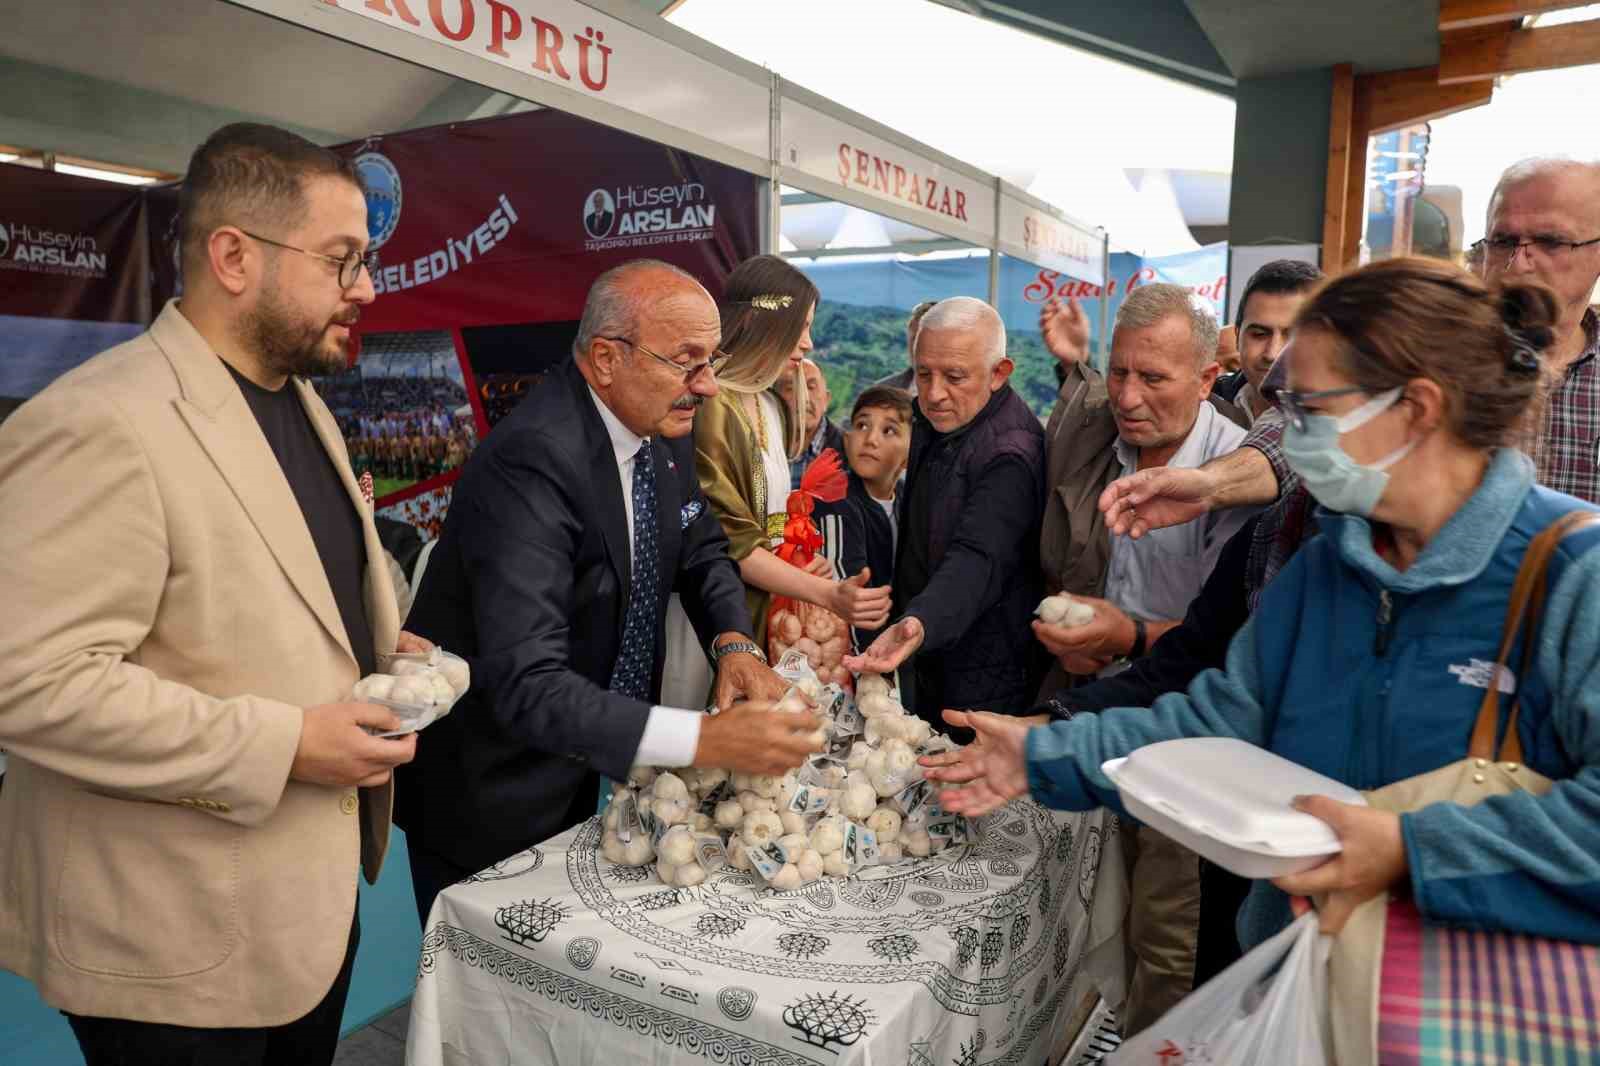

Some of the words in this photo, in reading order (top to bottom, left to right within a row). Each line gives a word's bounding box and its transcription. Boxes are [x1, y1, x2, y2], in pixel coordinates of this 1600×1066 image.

[616, 178, 705, 208] Hüseyin
[837, 143, 968, 222] ŞENPAZAR
[618, 204, 716, 235] ARSLAN
[14, 244, 107, 269] ARSLAN
[373, 193, 519, 294] BELEDİYESİ
